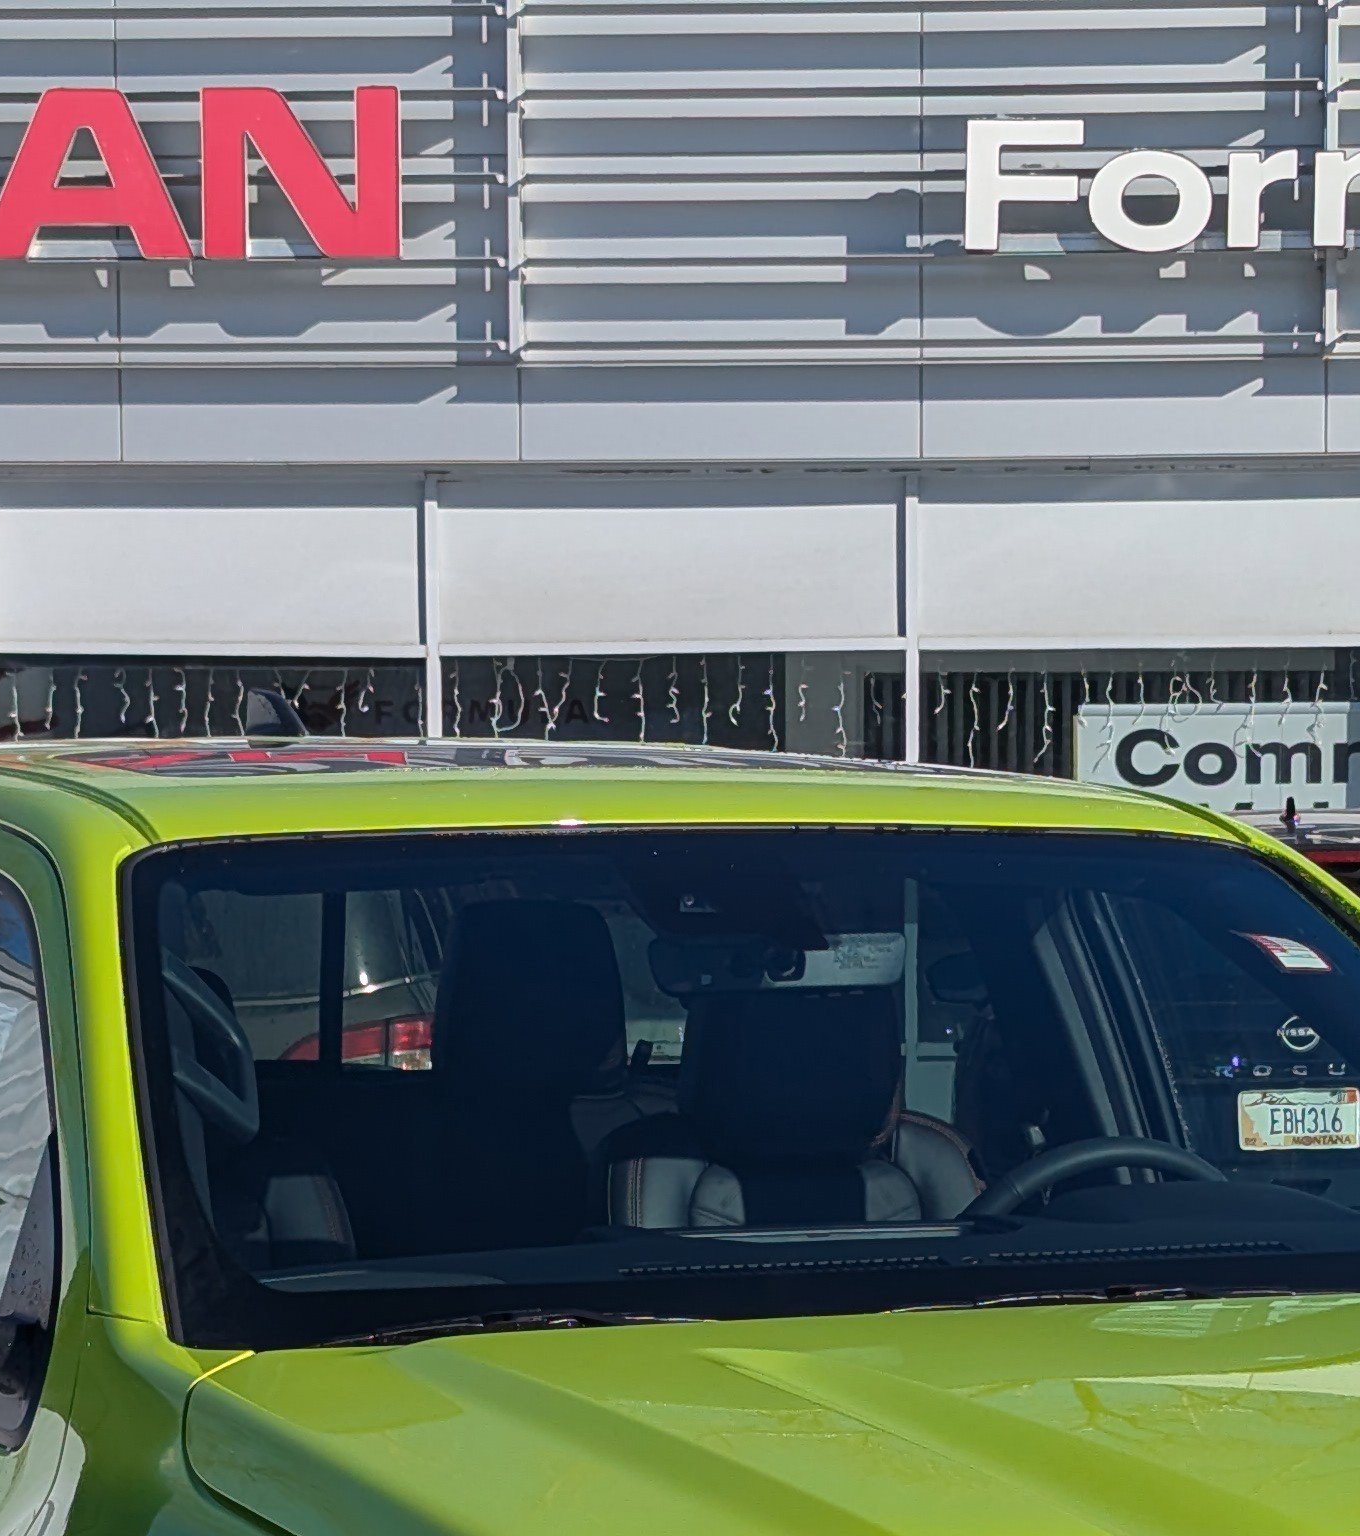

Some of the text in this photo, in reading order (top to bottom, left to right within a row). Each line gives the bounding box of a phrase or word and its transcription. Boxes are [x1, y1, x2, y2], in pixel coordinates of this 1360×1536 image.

[1276, 1027, 1317, 1037] NISSA
[1215, 1062, 1346, 1078] ROGU
[1269, 1106, 1343, 1136] EBH316
[1290, 1135, 1352, 1147] MONTANA
